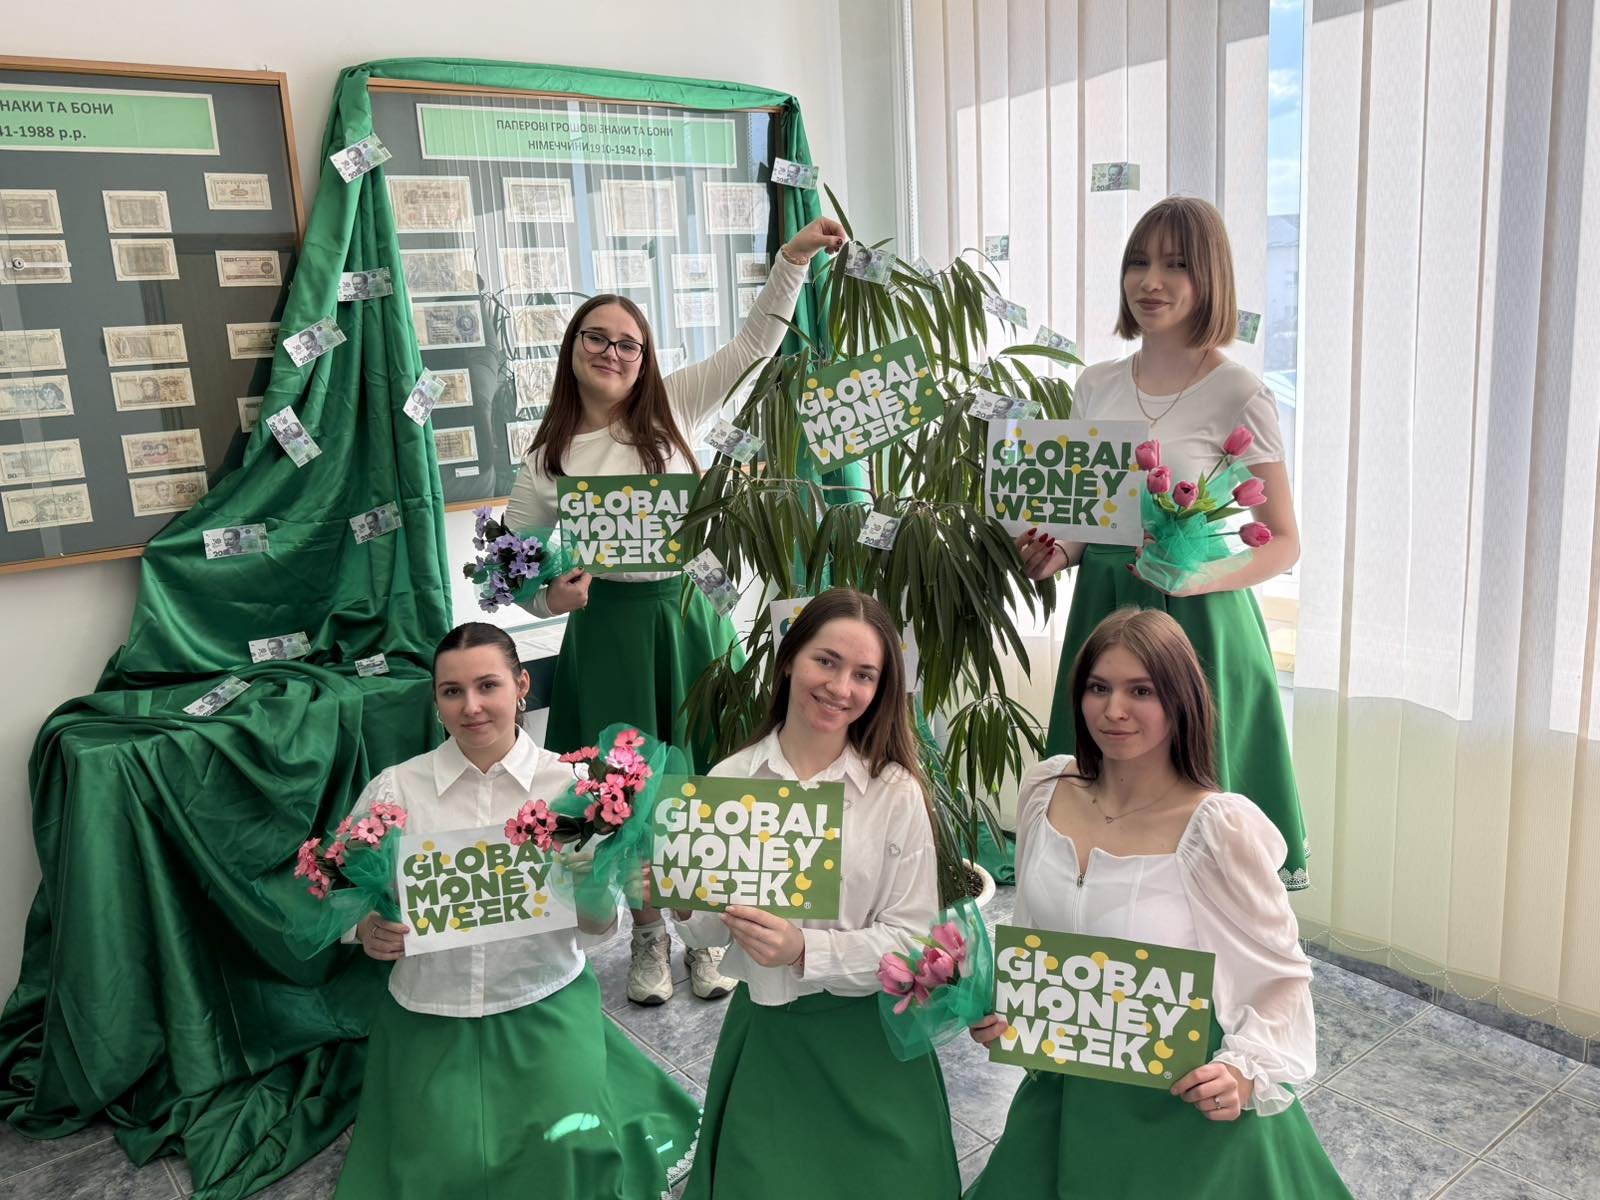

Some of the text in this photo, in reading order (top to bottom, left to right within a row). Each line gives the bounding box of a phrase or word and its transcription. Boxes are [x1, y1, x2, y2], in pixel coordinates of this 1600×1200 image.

[47, 101, 67, 113] ТА
[71, 102, 114, 115] БОНИ
[59, 128, 87, 141] р.р.
[496, 119, 673, 137] ПАПЕРОВІ ГРОШОВІ ЗНАКИ ТА БОНИ
[527, 139, 589, 152] НІМЕЧЧИНИ
[796, 354, 929, 417] GLOBAL
[802, 378, 919, 443] MONEY
[142, 443, 168, 456] 20
[709, 438, 719, 447] 20
[809, 409, 911, 465] WEEK
[992, 438, 1135, 470] GLOBAL
[990, 467, 1128, 499] MONEY
[560, 489, 690, 516] GLOBAL
[989, 493, 1100, 527] WEEK
[561, 513, 685, 540] MONEY
[864, 536, 874, 544] 20
[213, 550, 223, 558] 20
[561, 539, 666, 565] WEEK
[689, 569, 698, 580] 20
[655, 797, 840, 838] GLOBAL
[653, 833, 824, 871] MONEY
[405, 863, 552, 909] MONEY
[651, 865, 792, 907] WEEK
[407, 893, 533, 936] WEEK
[997, 946, 1209, 1010] GLOBAL
[996, 980, 1188, 1039] MONEY
[994, 1012, 1150, 1074] WEEK
